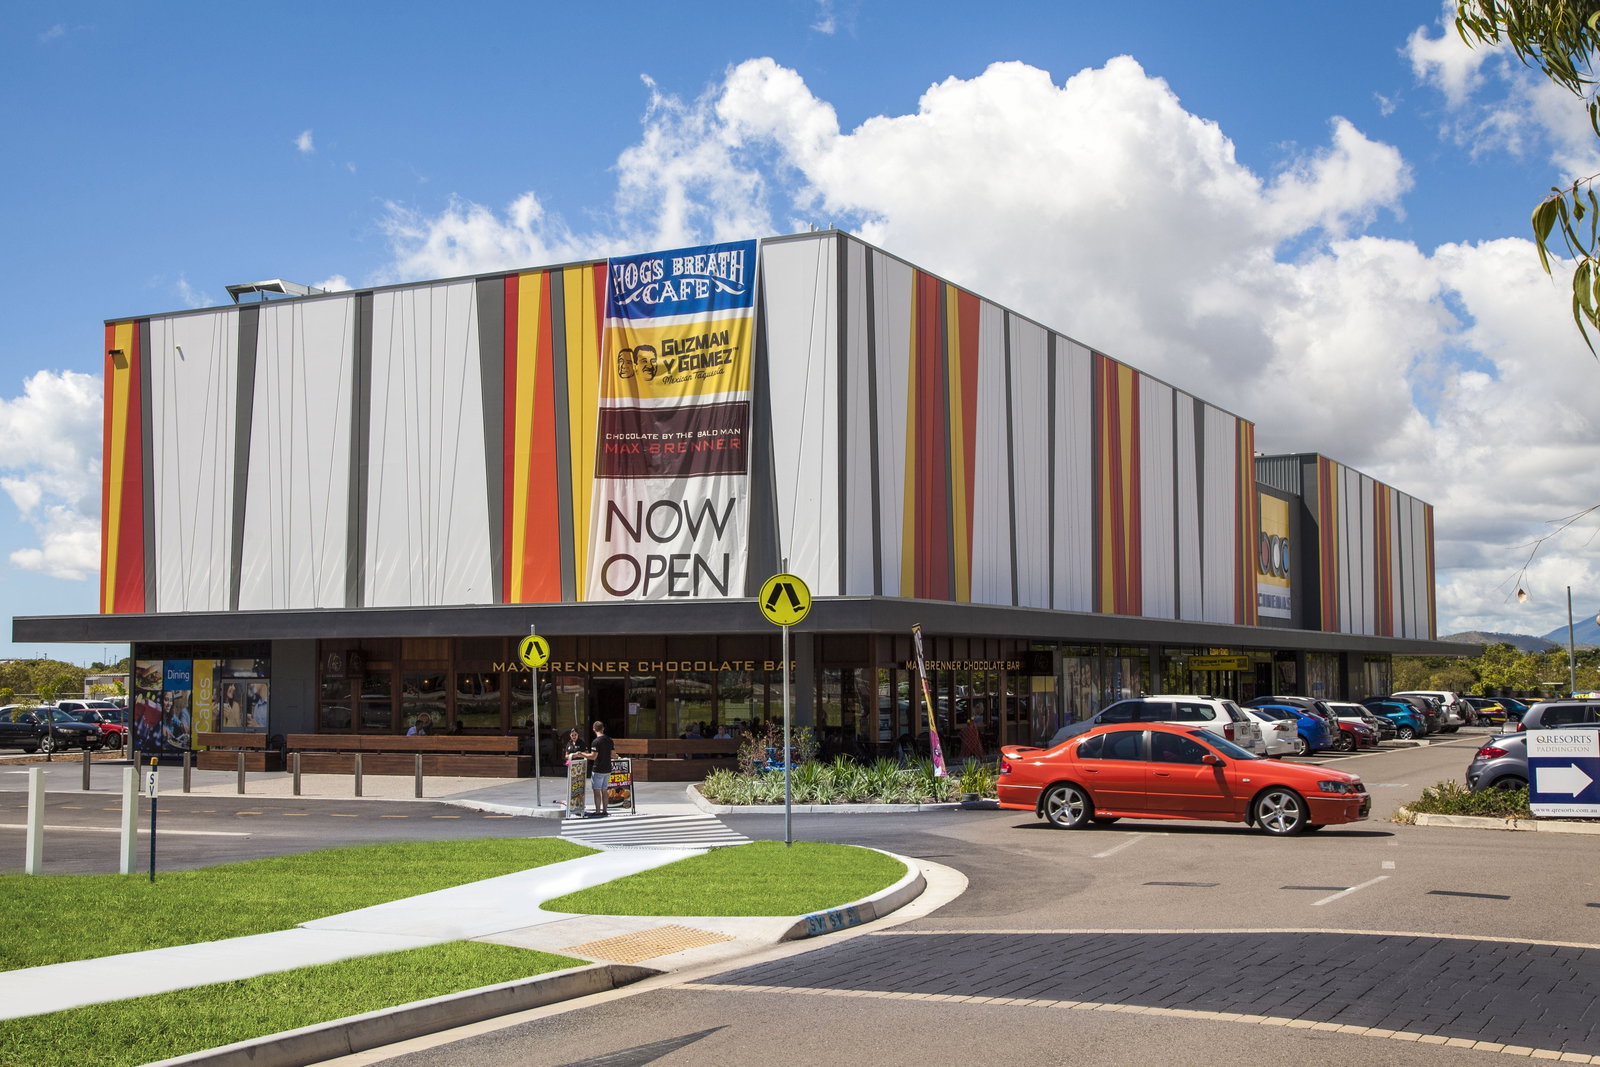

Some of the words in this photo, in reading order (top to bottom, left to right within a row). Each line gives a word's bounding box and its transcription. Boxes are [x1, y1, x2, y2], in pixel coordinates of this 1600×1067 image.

[672, 250, 745, 286] BREATH
[642, 278, 711, 305] CAFE
[661, 330, 729, 356] GUZMAN
[663, 359, 675, 374] Y
[662, 374, 693, 384] Mexican
[694, 367, 725, 381] Taqueria
[697, 429, 718, 438] BALD
[605, 442, 640, 454] MAX
[648, 438, 741, 454] BRENNER
[605, 498, 737, 543] NOW
[600, 553, 730, 597] OPEN
[492, 661, 530, 672] MAX
[538, 661, 630, 672] BRENNER
[638, 660, 755, 672] CHOCOLATE
[905, 660, 920, 671] MA
[925, 660, 962, 671] BRENNER
[963, 660, 1005, 671] CHOCOLATE
[1006, 661, 1020, 670] BAR
[167, 669, 190, 682] Dining
[195, 677, 211, 734] Cafes
